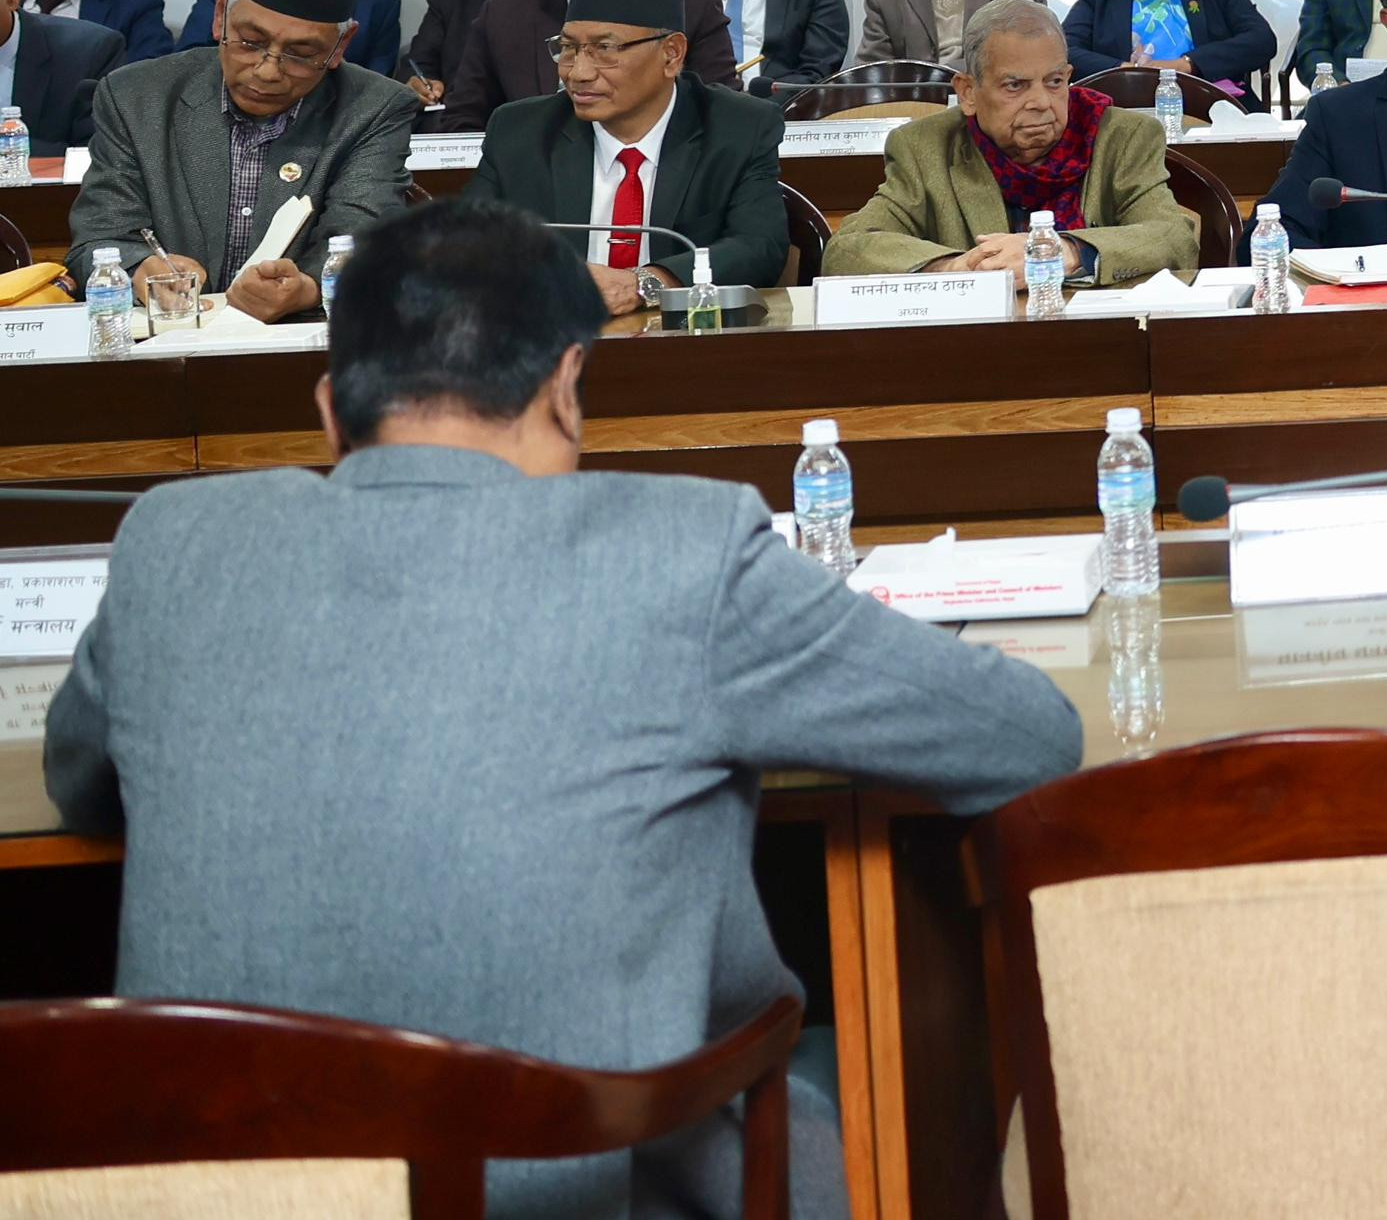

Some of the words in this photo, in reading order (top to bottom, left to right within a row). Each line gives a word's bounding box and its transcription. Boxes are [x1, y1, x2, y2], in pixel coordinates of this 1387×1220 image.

[851, 282, 900, 296] माननीय
[904, 282, 938, 293] महन्थ
[943, 279, 976, 295] ठाकुर
[897, 307, 928, 317] अध्यक्ष
[5, 322, 44, 338] सुवाल
[15, 595, 44, 609] मन्त्री
[11, 619, 77, 634] मन्त्रालय
